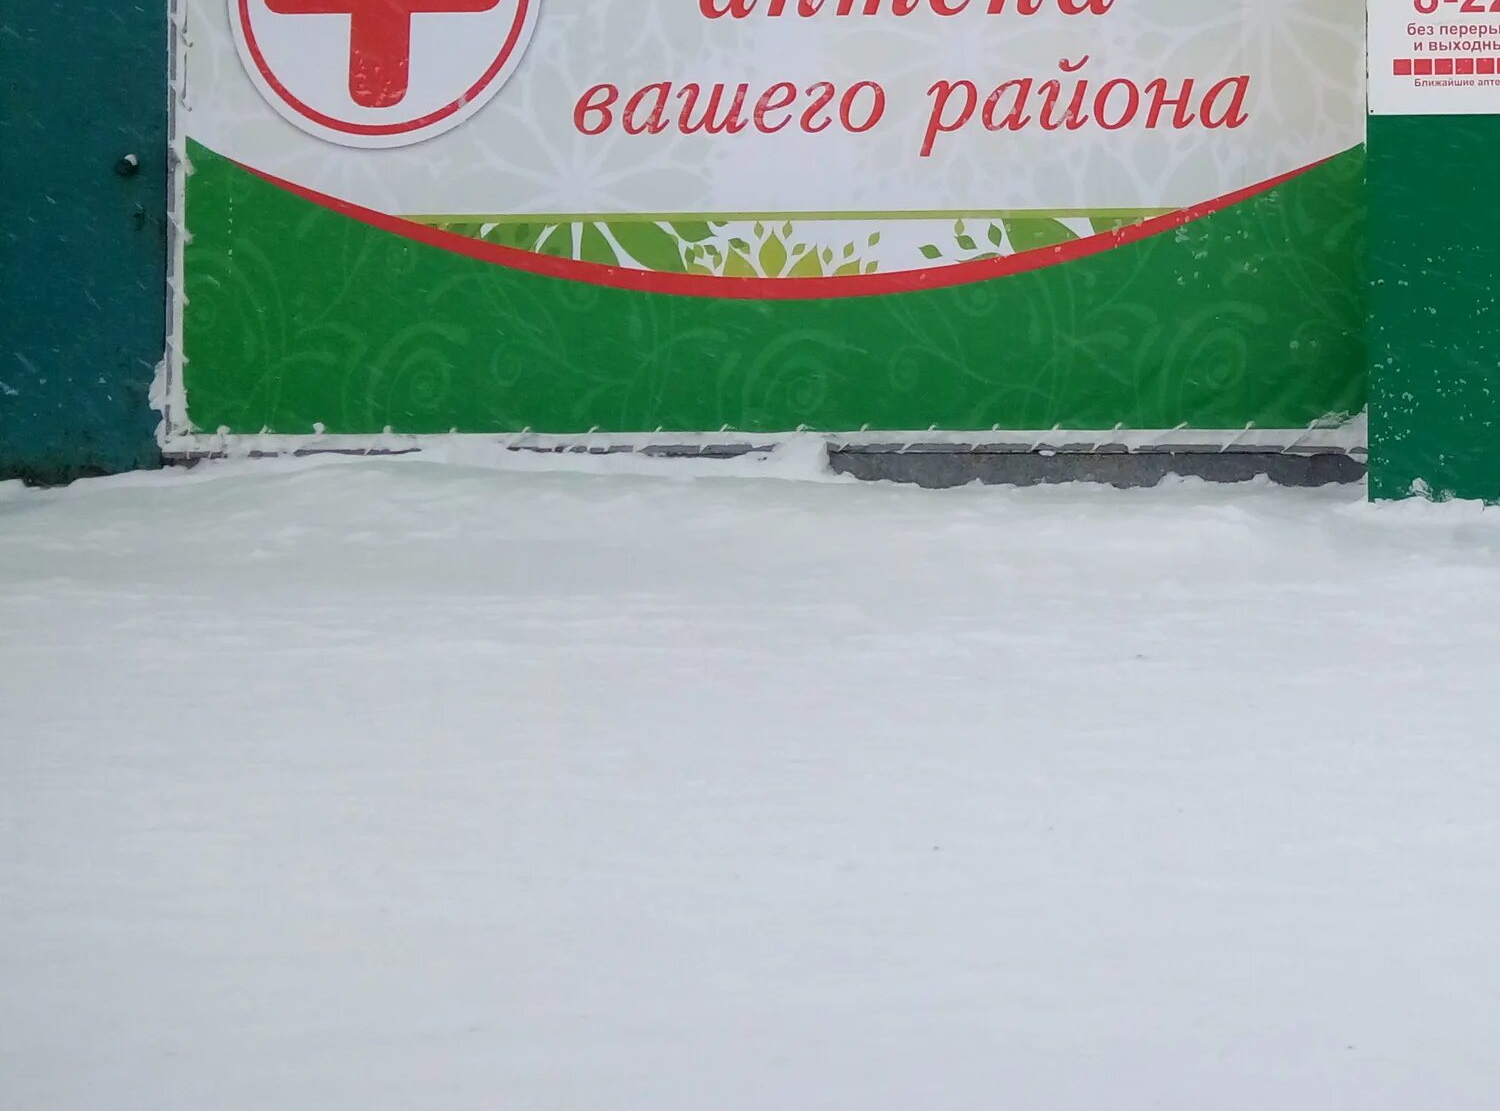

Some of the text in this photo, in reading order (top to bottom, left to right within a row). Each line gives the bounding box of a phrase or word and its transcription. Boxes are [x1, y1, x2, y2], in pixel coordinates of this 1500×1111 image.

[1407, 23, 1434, 36] без
[1413, 41, 1423, 51] и
[1414, 78, 1475, 88] Ближайшие
[572, 55, 1252, 157] вашего района
